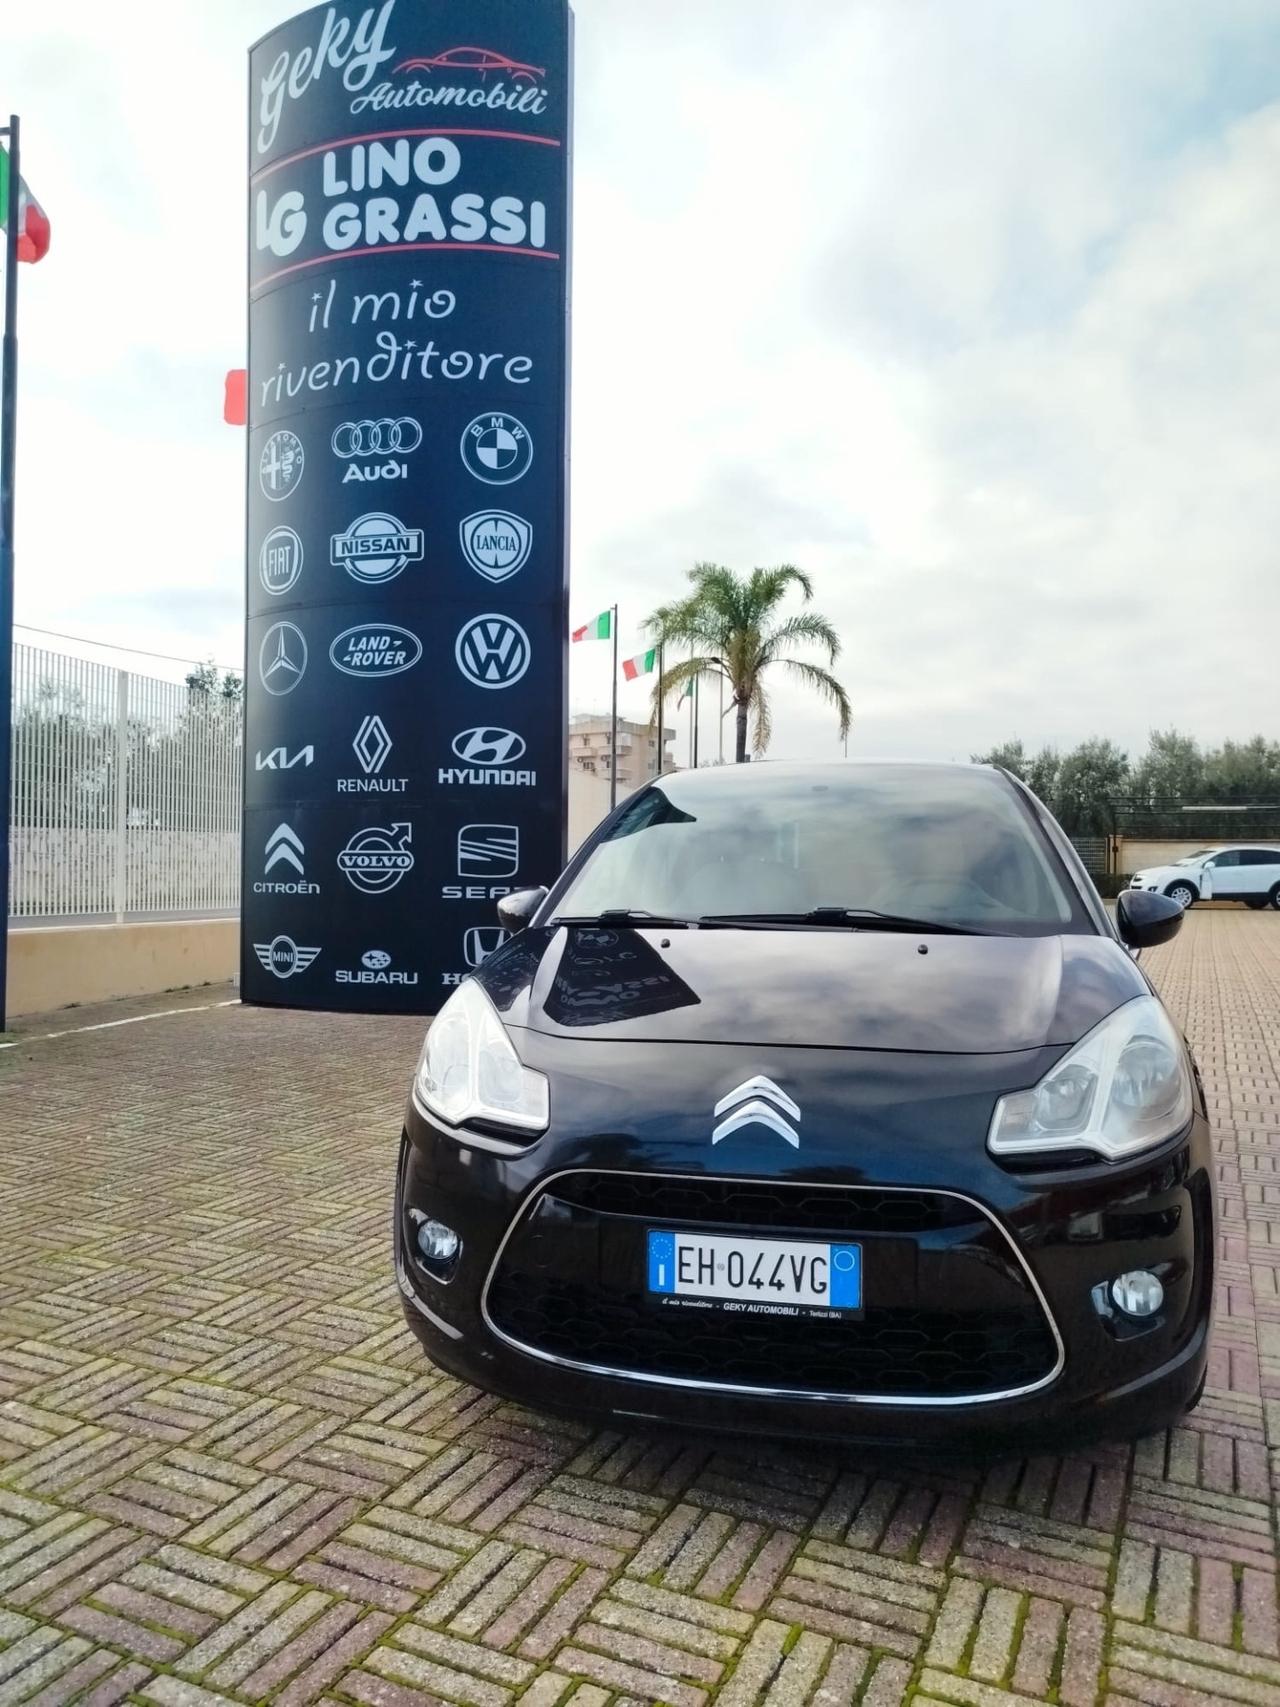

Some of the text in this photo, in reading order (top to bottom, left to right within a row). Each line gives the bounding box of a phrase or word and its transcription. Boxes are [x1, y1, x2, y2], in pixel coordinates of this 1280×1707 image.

[350, 80, 549, 115] Automobili
[323, 137, 461, 197] LINO
[322, 193, 546, 251] GRASSI
[309, 279, 456, 333] il mio
[261, 331, 533, 407] rivenditore
[470, 417, 525, 441] BMW
[341, 537, 411, 555] NISSAN
[476, 534, 517, 552] LANCIA
[268, 545, 291, 577] FIAT
[348, 635, 389, 651] LAND
[350, 651, 406, 666] ROVER
[337, 778, 409, 793] RENAULT
[438, 768, 536, 786] HYUNDAI
[341, 855, 411, 868] VOLVO
[441, 886, 521, 899] SEA
[272, 950, 295, 963] MINI
[335, 970, 418, 985] SUBARU
[723, 1302, 747, 1312] GEKY
[747, 1304, 799, 1316] AUTOMOBILI
